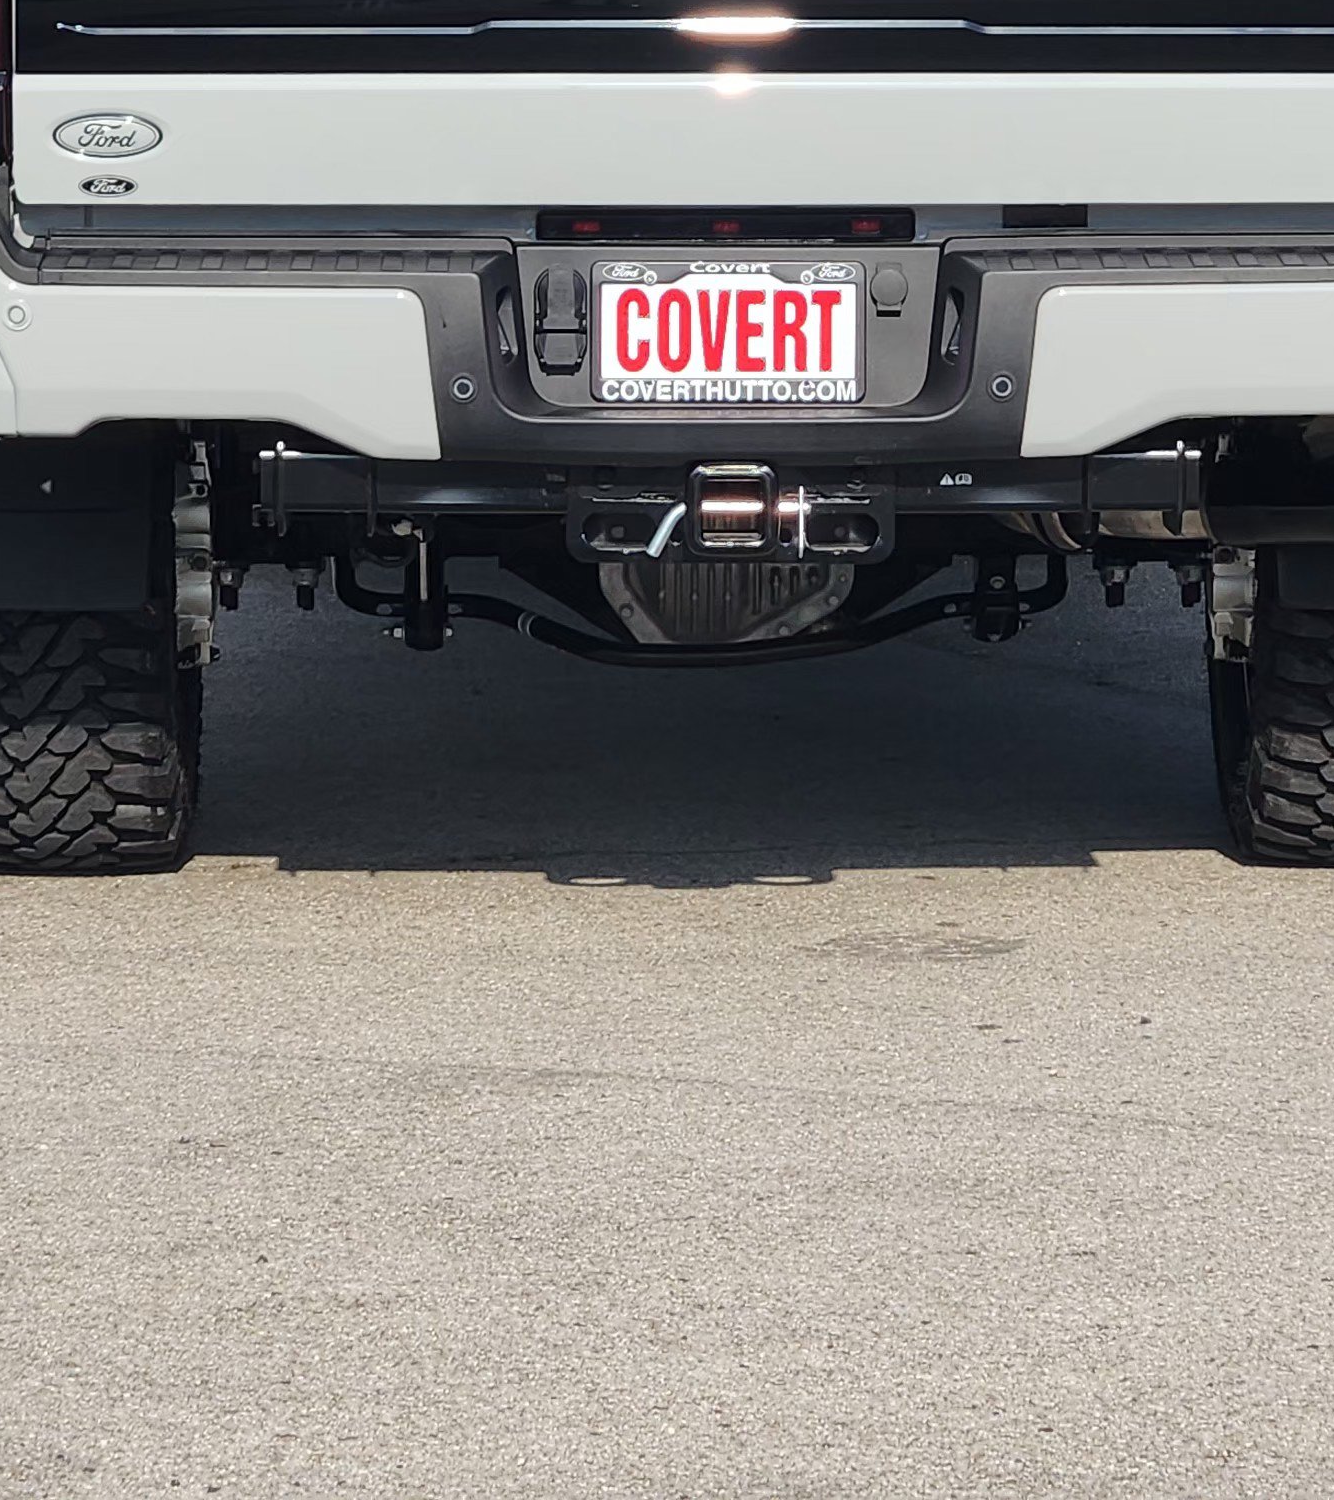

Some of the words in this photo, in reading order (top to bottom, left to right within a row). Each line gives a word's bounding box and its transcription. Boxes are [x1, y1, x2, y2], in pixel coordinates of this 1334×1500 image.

[77, 123, 137, 148] Ford
[90, 178, 128, 193] Ford
[610, 264, 640, 278] Ford
[689, 261, 771, 273] Covert
[818, 264, 847, 278] Ford
[617, 288, 841, 372] COVERT
[601, 380, 857, 401] COVERTHUTTO.COM
